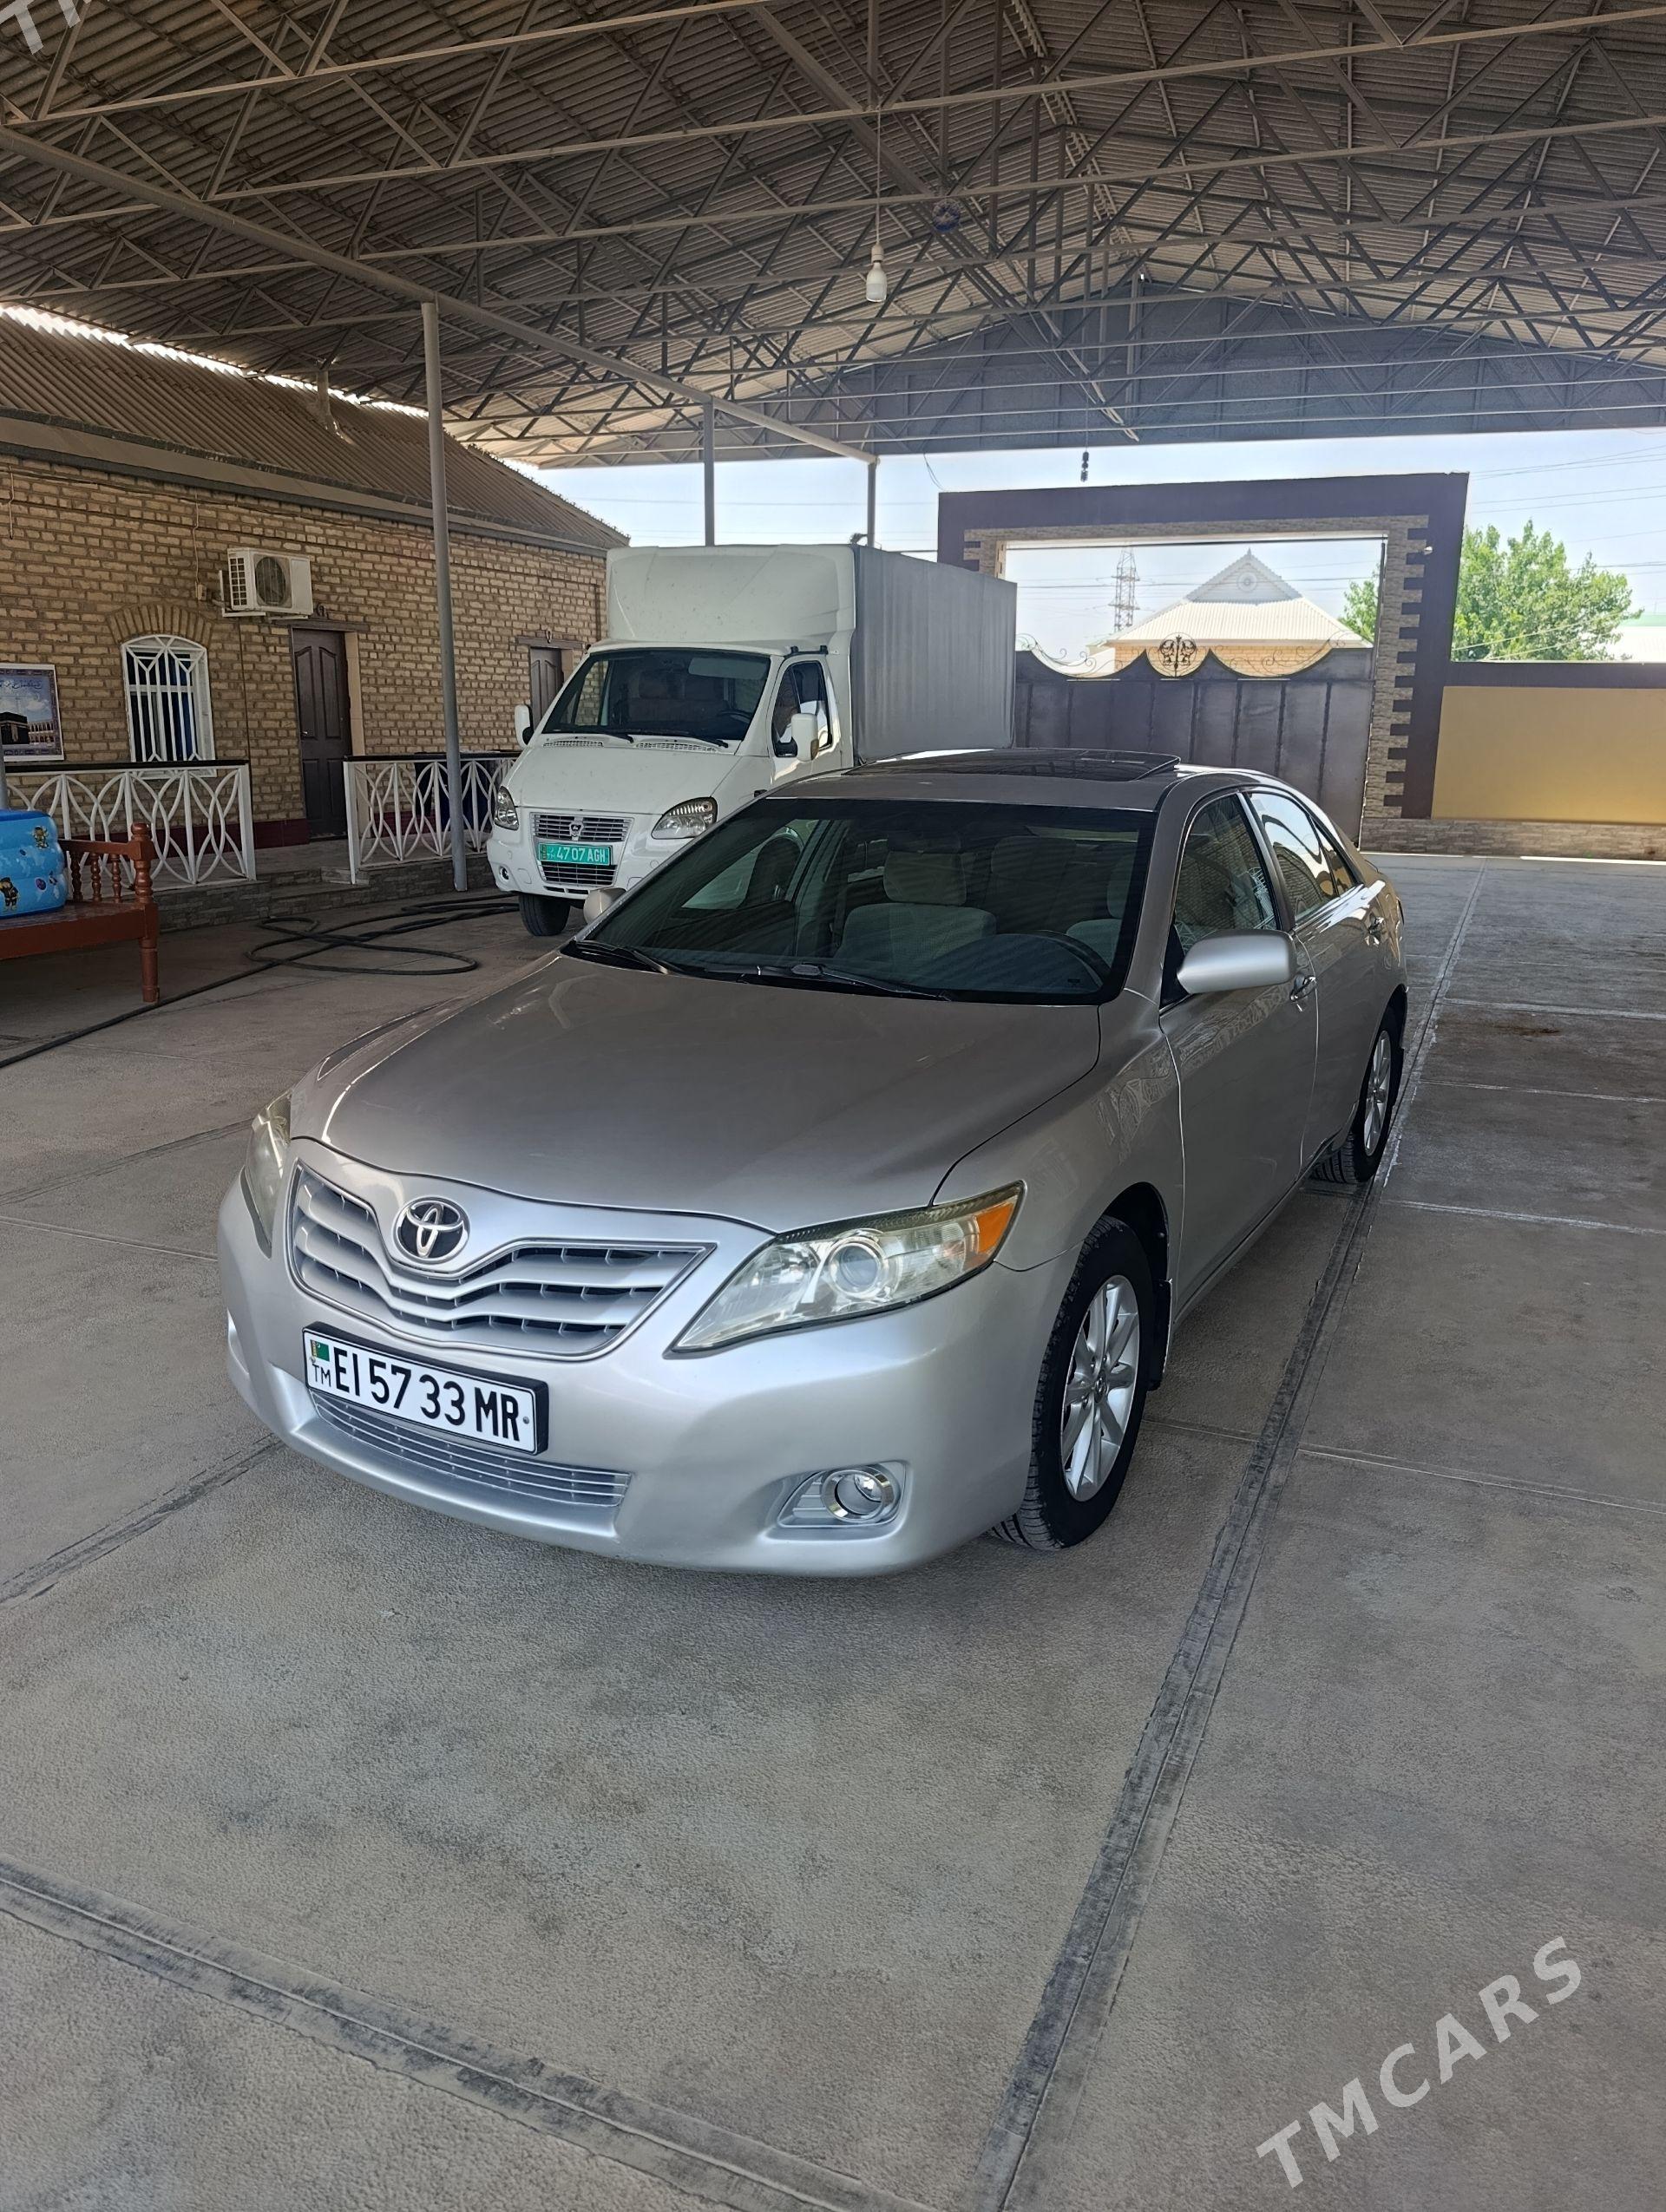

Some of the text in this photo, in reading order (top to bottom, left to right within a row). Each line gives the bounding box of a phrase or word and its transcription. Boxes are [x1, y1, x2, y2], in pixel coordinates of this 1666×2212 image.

[587, 848, 606, 863] AGH
[312, 1363, 331, 1387] TM
[333, 1346, 521, 1442] EI 57 33 MR
